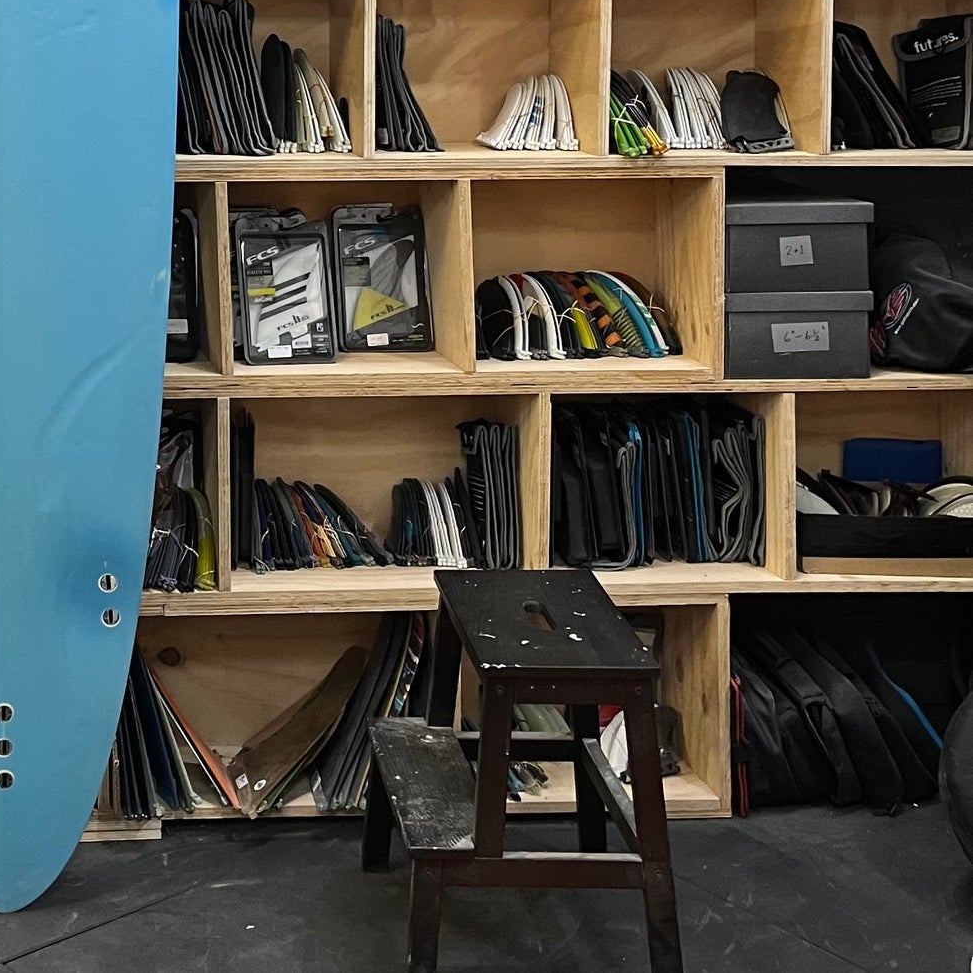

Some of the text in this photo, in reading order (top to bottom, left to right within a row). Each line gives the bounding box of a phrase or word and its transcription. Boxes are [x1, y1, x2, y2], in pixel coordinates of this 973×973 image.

[343, 236, 375, 255] FCS
[246, 246, 279, 265] FCS
[371, 310, 387, 320] FCS
